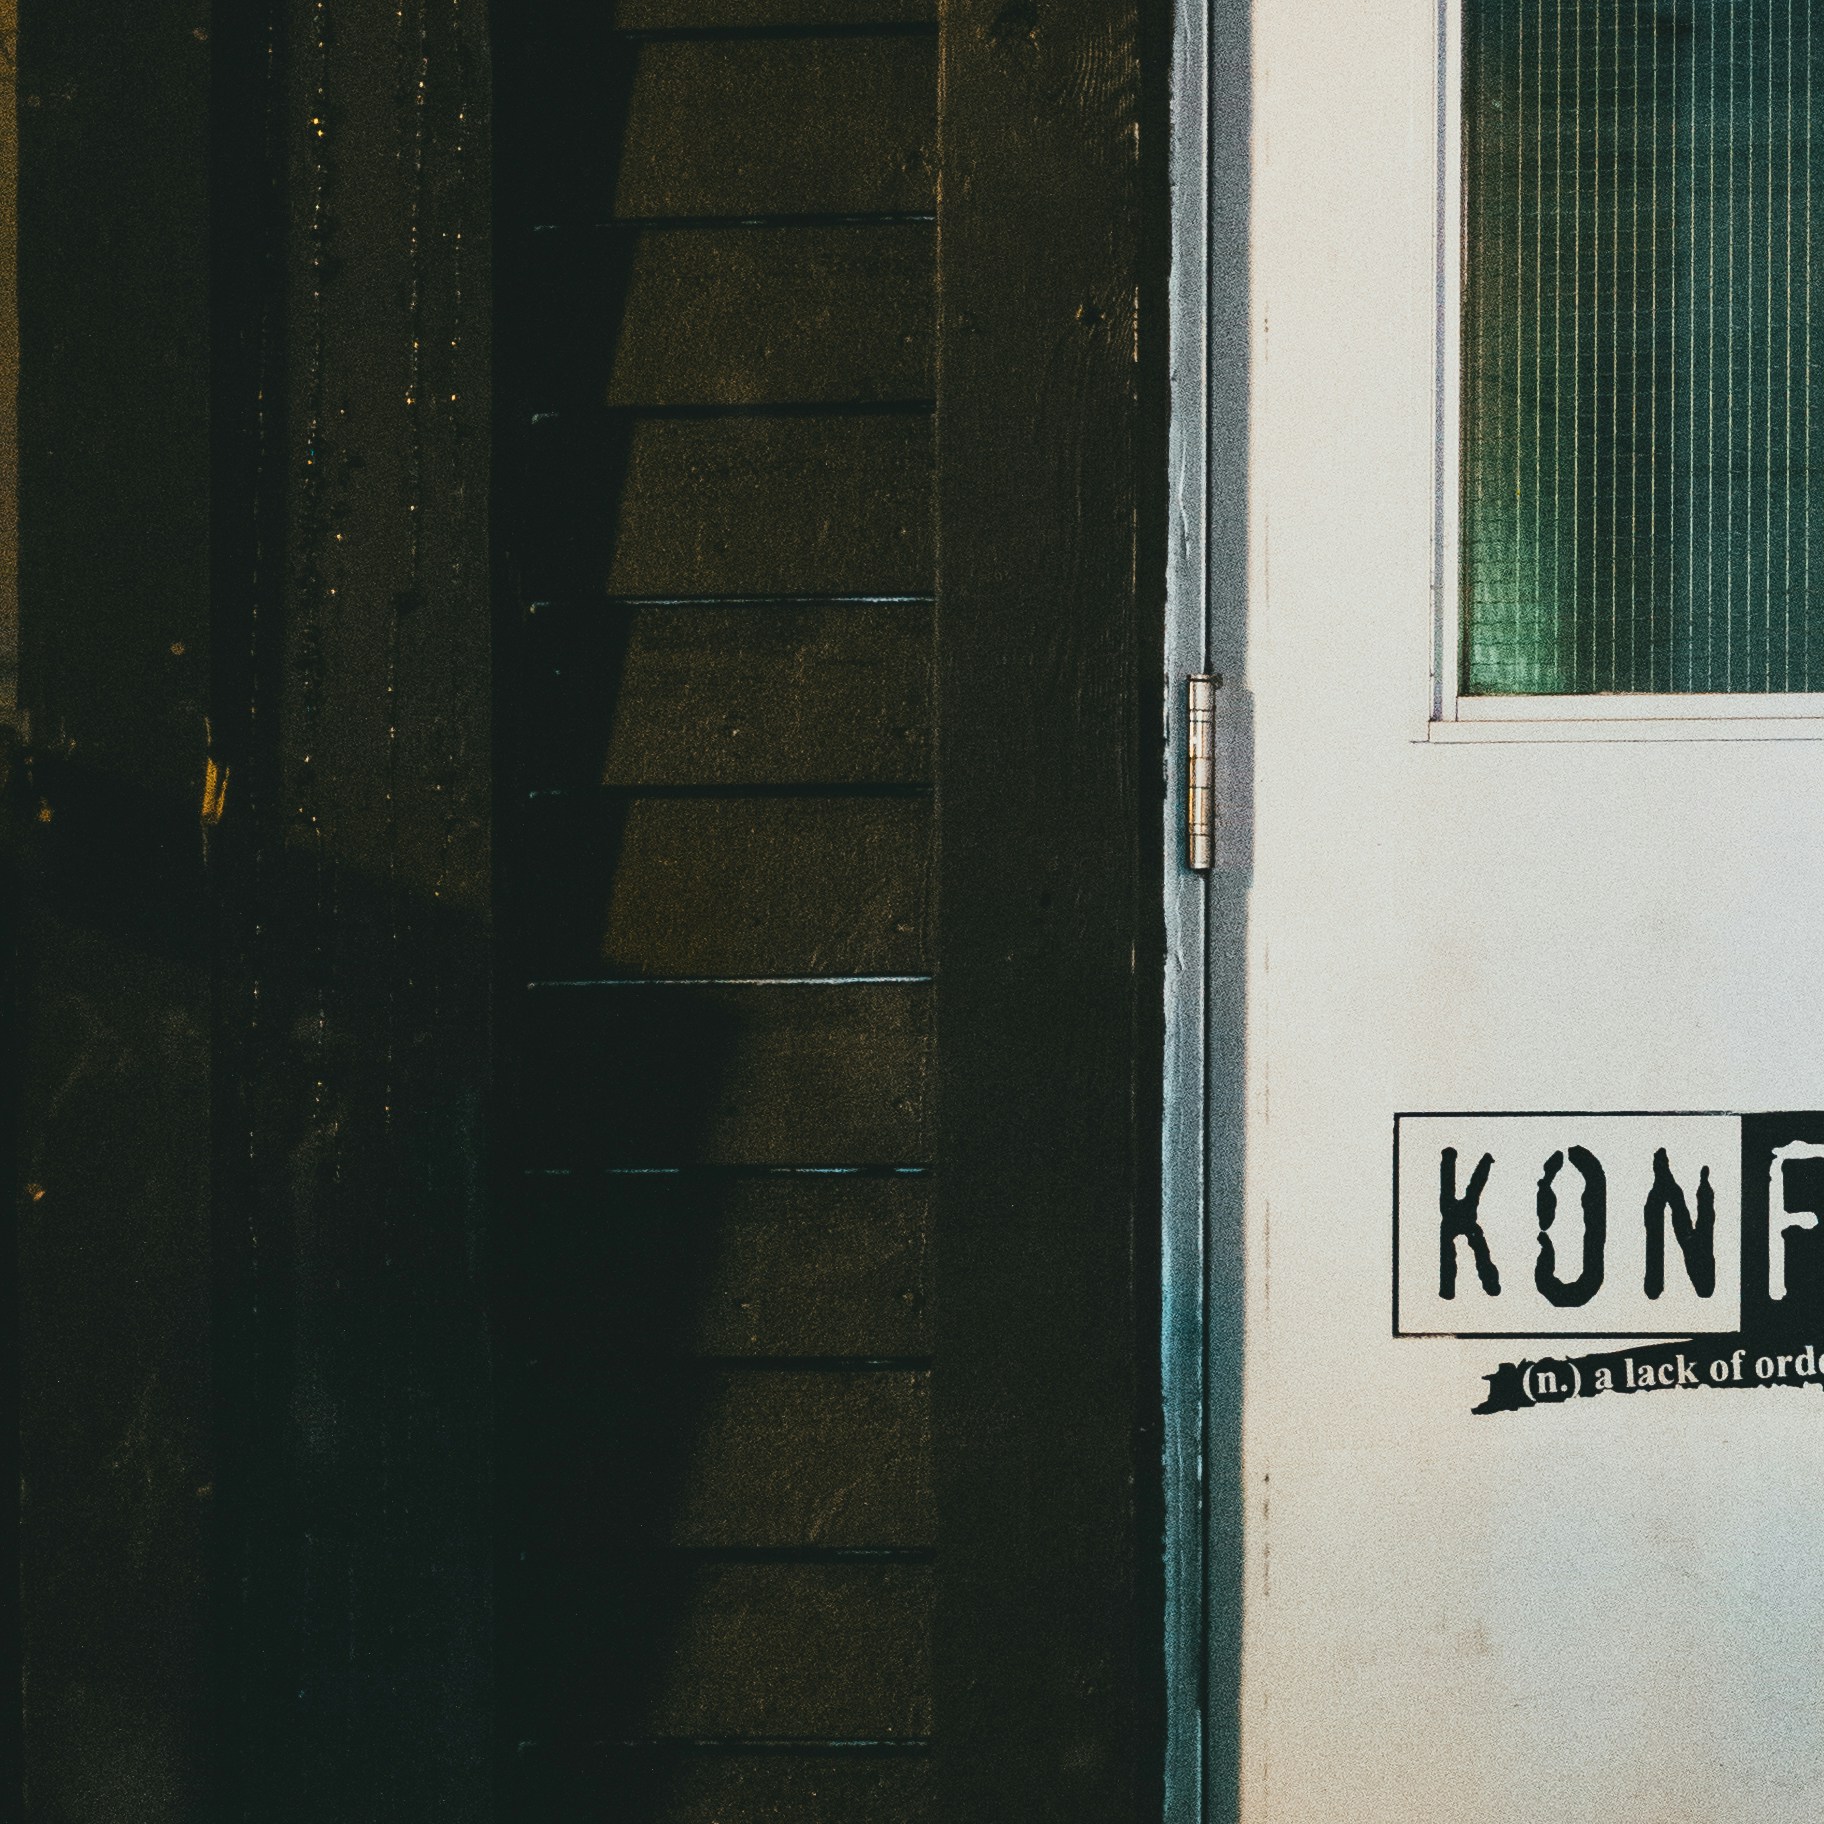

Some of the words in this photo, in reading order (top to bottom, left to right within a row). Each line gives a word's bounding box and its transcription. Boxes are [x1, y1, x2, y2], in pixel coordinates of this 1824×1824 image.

[1521, 1362, 1582, 1403] (n.)
[1594, 1367, 1614, 1391] a
[1625, 1354, 1700, 1389] lack
[1709, 1349, 1747, 1382] of
